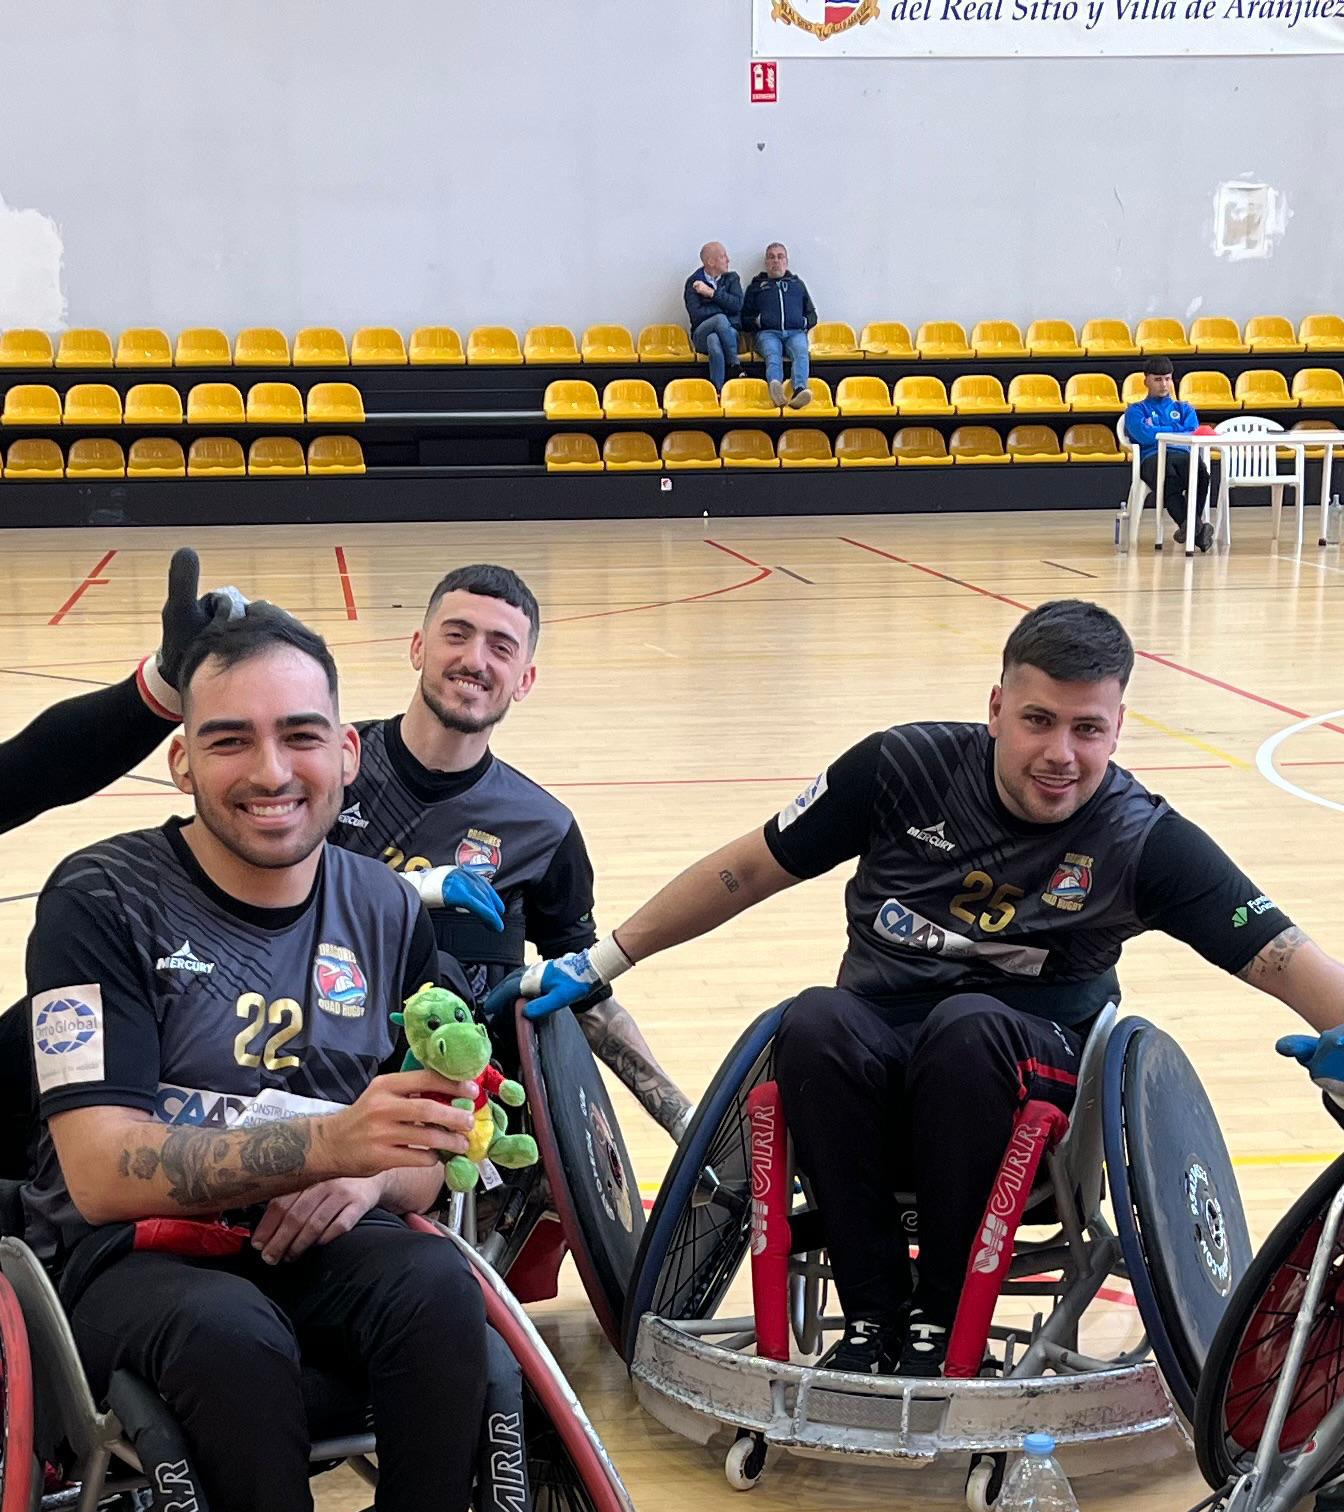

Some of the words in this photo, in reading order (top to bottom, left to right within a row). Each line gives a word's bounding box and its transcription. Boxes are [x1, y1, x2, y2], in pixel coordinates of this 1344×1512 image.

[891, 0, 931, 21] del
[940, 0, 1002, 21] Real
[1012, 0, 1077, 21] Sitio
[1086, 2, 1104, 29] y
[1116, 0, 1176, 20] Villa
[1185, 0, 1216, 20] de
[467, 828, 503, 848] DRAGONES
[906, 826, 955, 852] MERCURY
[949, 870, 1025, 933] 25
[156, 956, 215, 974] MERCURY
[37, 1016, 98, 1040] OrtoGlobal
[234, 992, 303, 1070] 22
